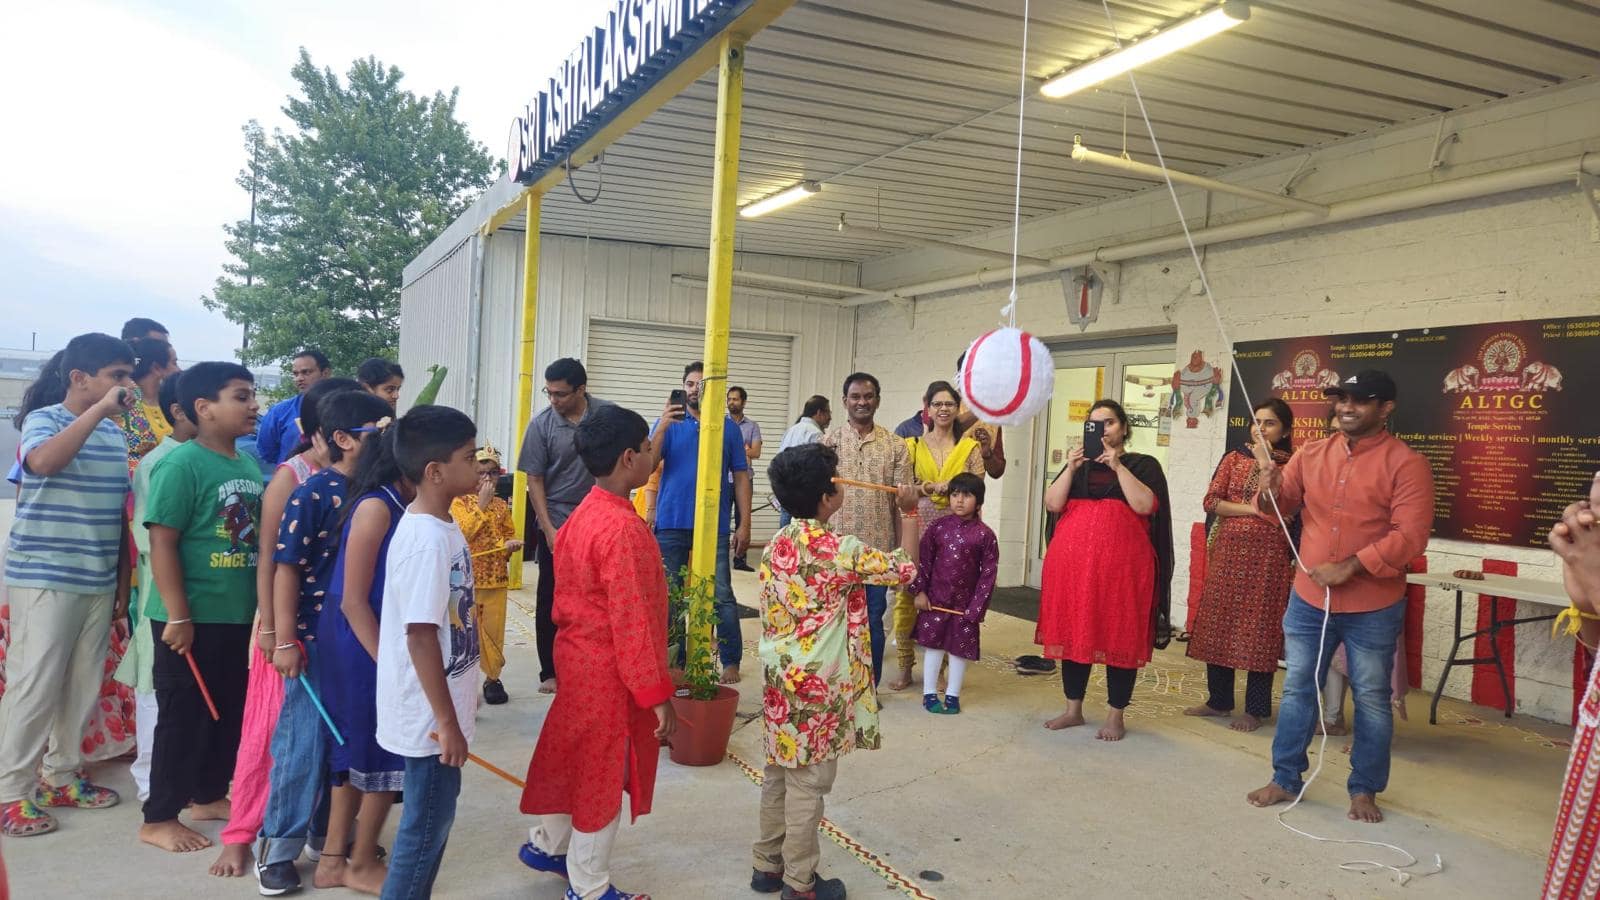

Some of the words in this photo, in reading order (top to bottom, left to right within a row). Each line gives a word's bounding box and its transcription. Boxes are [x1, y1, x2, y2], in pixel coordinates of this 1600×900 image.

[520, 91, 540, 172] SRI
[1282, 390, 1329, 400] ALTGC
[1460, 395, 1543, 409] ALTGC
[1230, 417, 1244, 427] SRI
[1467, 422, 1491, 431] Temple
[1492, 423, 1521, 431] Services
[1428, 433, 1457, 441] services
[1464, 433, 1493, 443] Weekly
[1496, 434, 1530, 443] services
[1538, 435, 1574, 446] monthly
[210, 553, 246, 567] SINCE
[247, 552, 258, 567] 20
